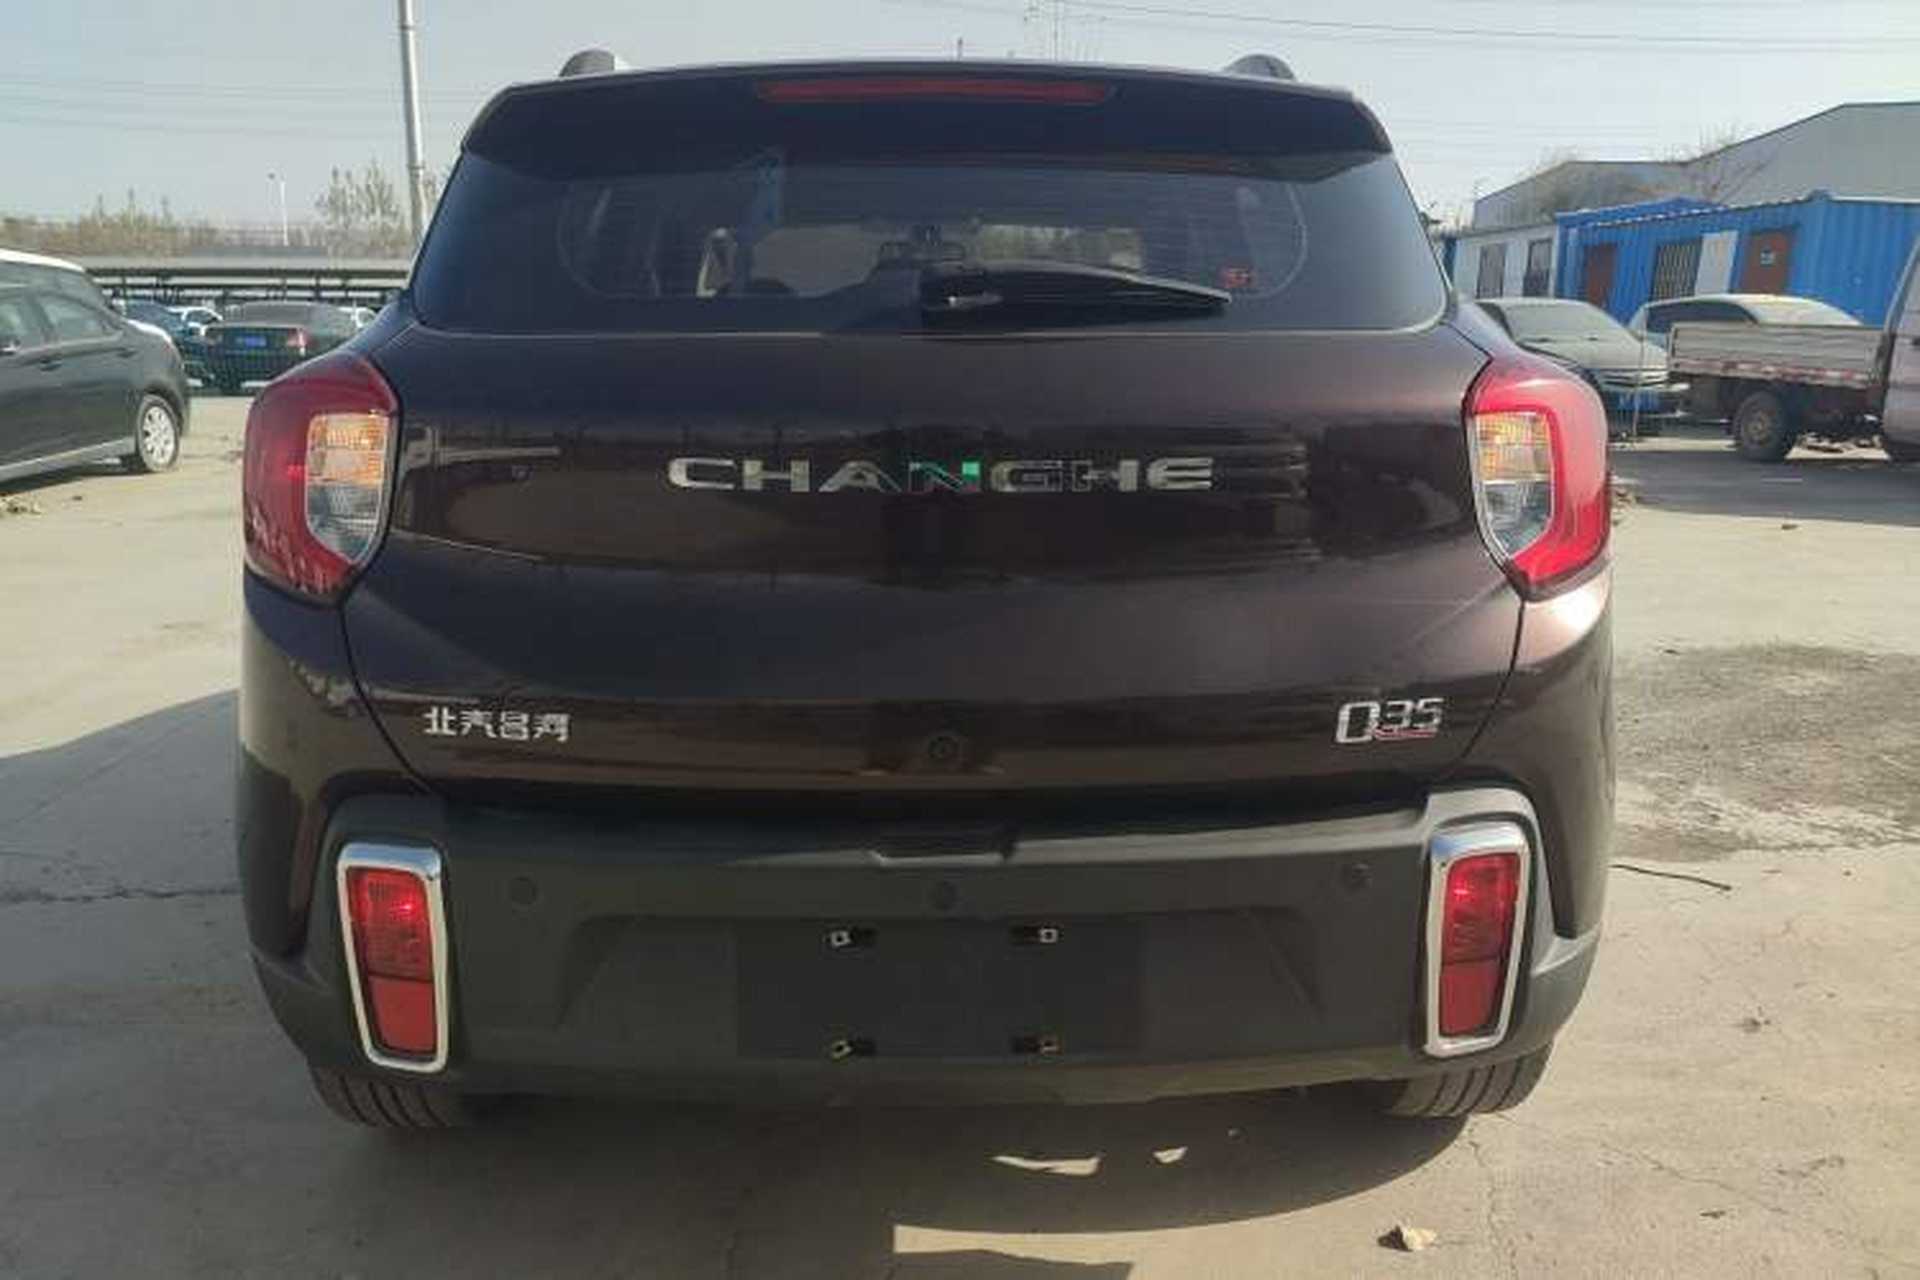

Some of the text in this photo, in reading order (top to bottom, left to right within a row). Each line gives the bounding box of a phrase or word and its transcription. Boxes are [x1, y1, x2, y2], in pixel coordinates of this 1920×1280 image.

[668, 457, 1213, 493] CHANGHE
[423, 706, 570, 742] 北汽昌河
